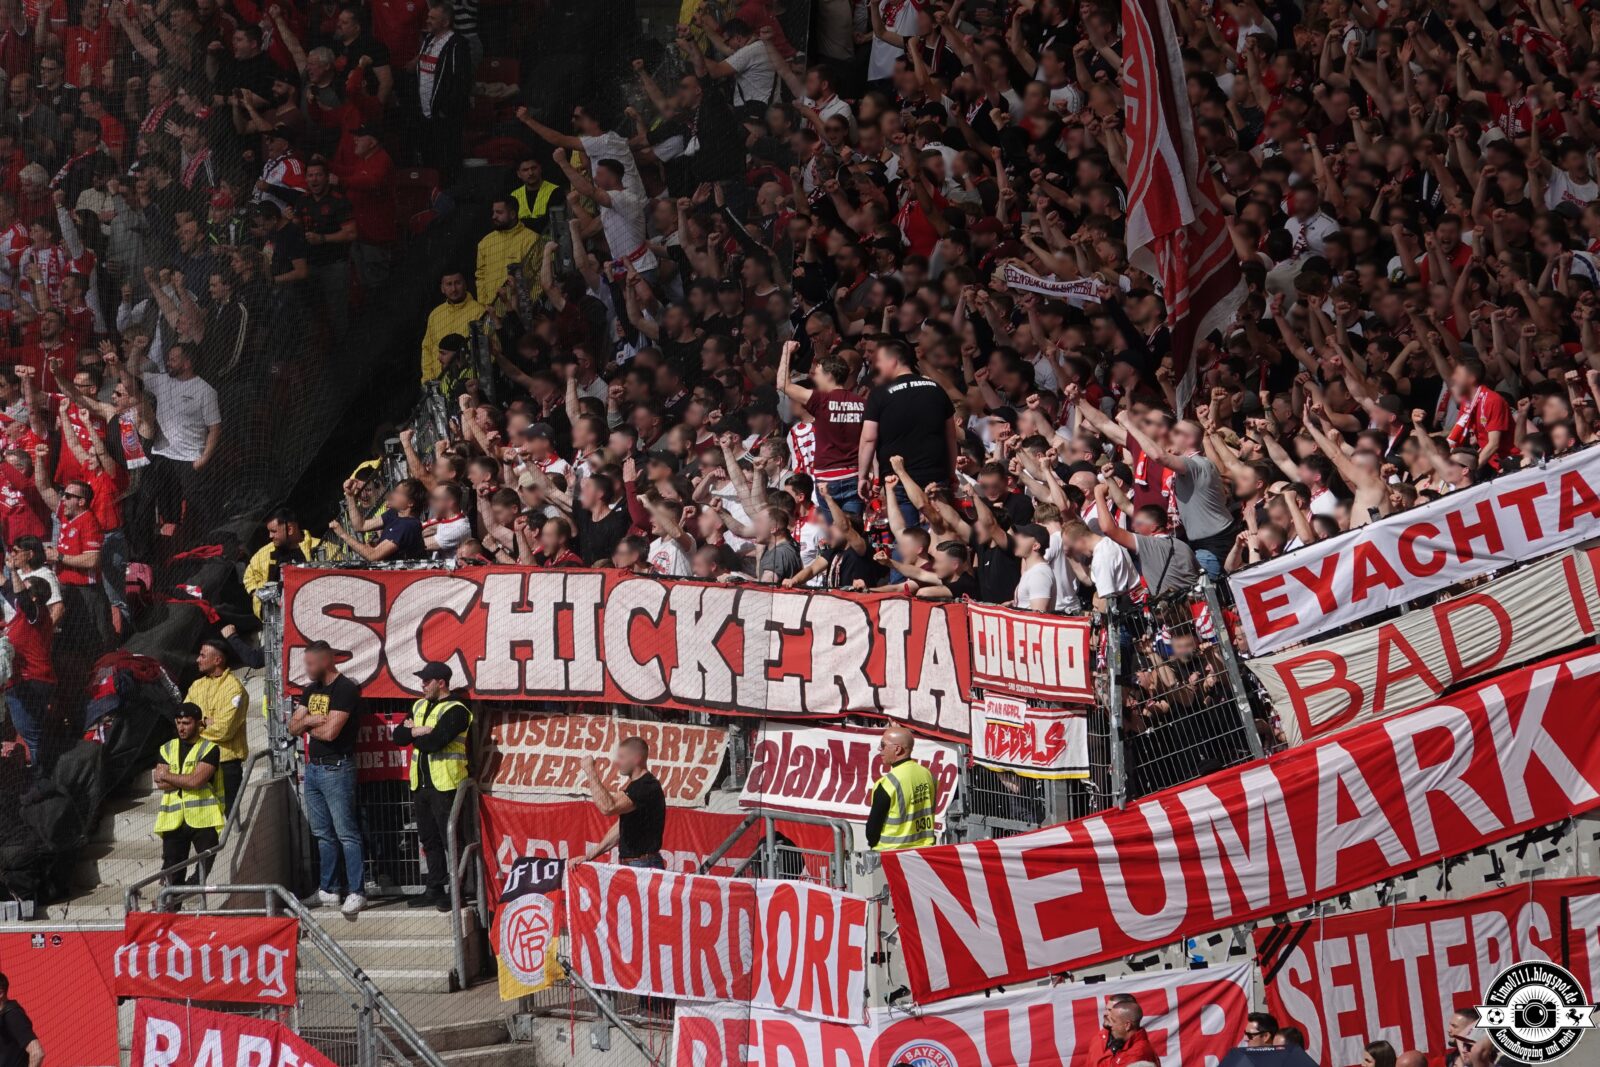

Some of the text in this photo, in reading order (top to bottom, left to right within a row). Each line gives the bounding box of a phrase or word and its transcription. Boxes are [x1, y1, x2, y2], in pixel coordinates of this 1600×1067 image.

[828, 400, 865, 412] ULTRAS
[829, 412, 863, 423] LIBER
[286, 572, 972, 738] SCHICKERIA
[971, 611, 1087, 689] COLEGIO
[1273, 593, 1514, 742] BAD
[747, 731, 958, 816] alarMsfe
[984, 721, 1067, 766] REBELS
[567, 863, 867, 1019] ROHRDORF
[905, 1047, 949, 1067] BAYERN
